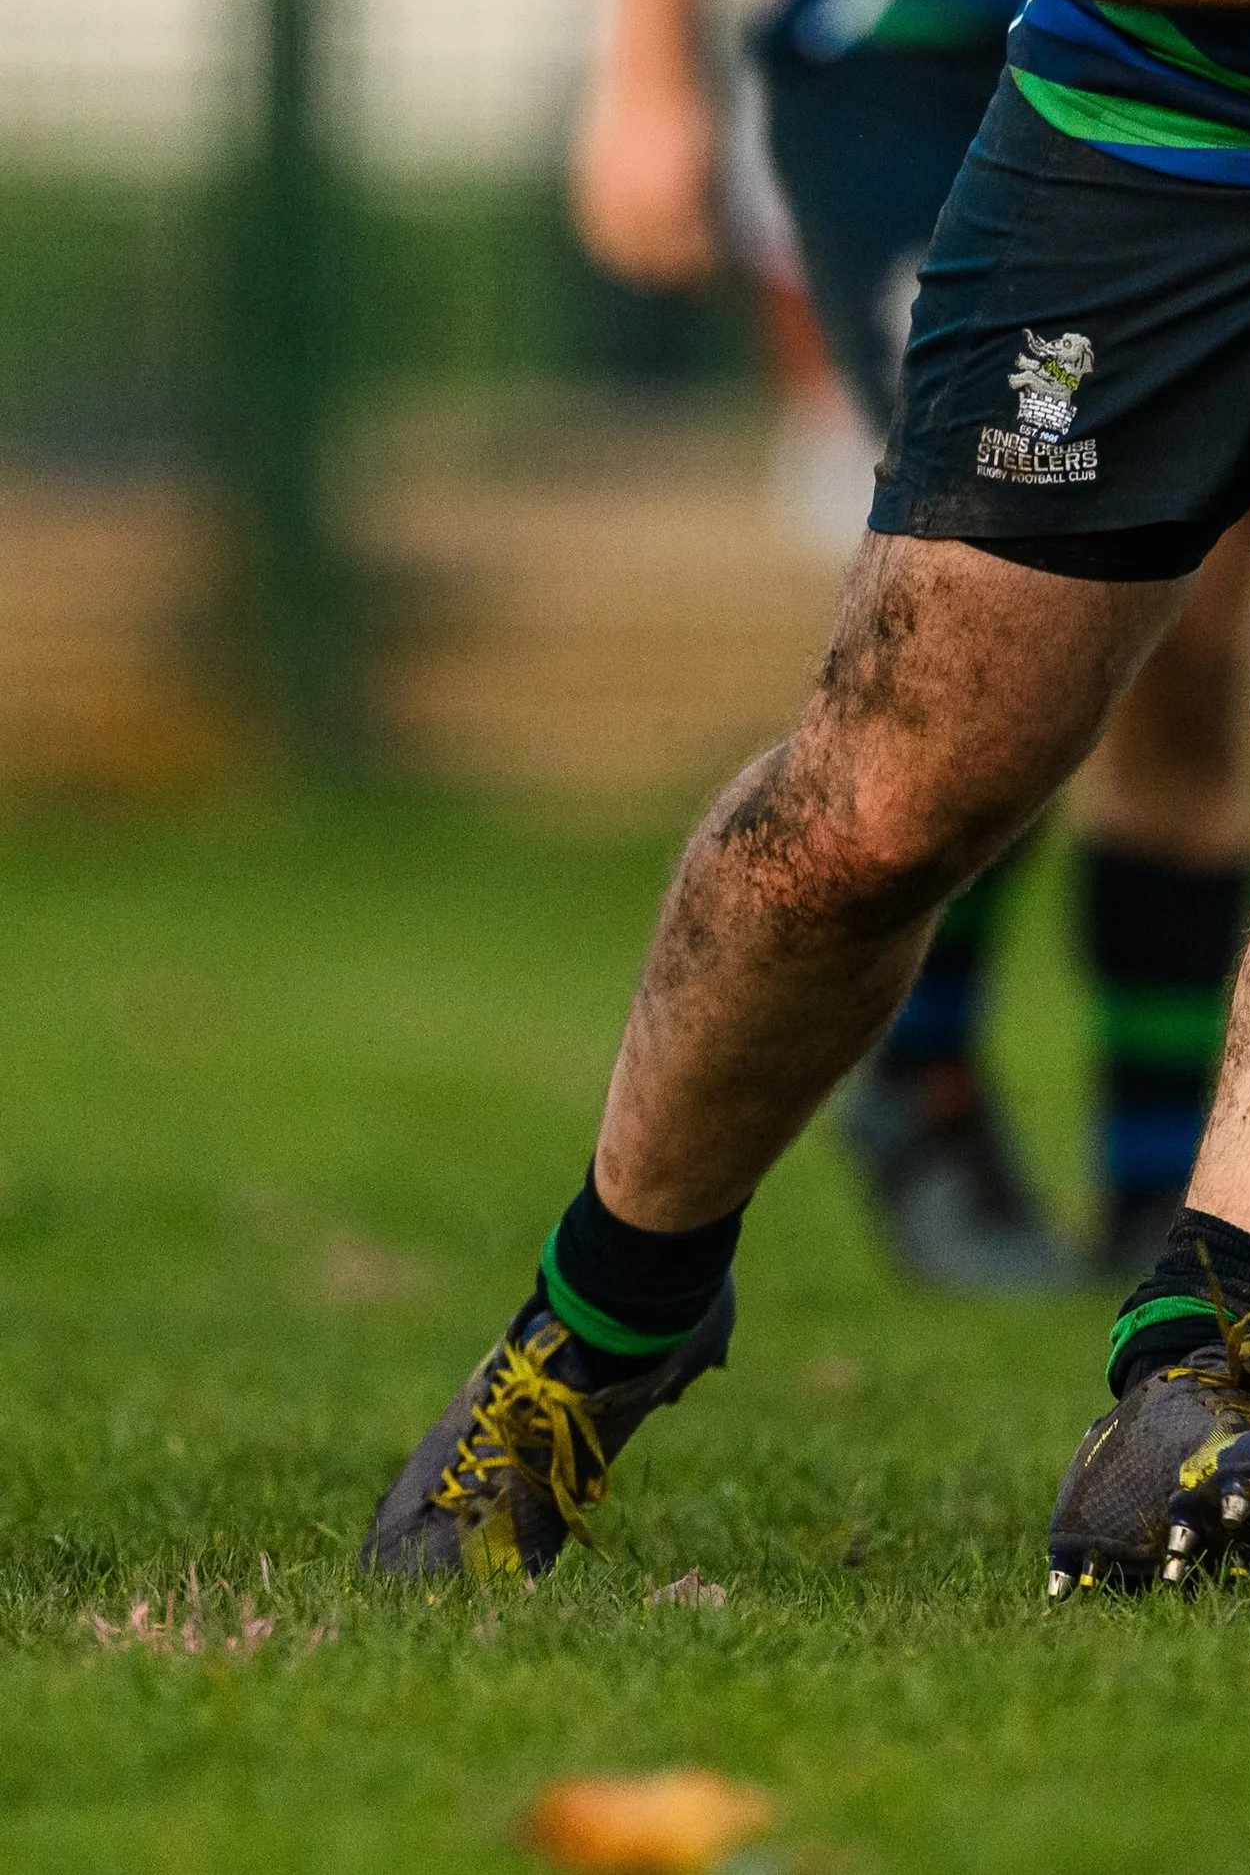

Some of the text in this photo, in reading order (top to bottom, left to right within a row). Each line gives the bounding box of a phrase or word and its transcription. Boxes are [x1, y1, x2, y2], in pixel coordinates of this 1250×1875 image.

[976, 442, 1099, 472] STEELERS
[976, 465, 1097, 485] RUGBY FOOTBALL CLUB
